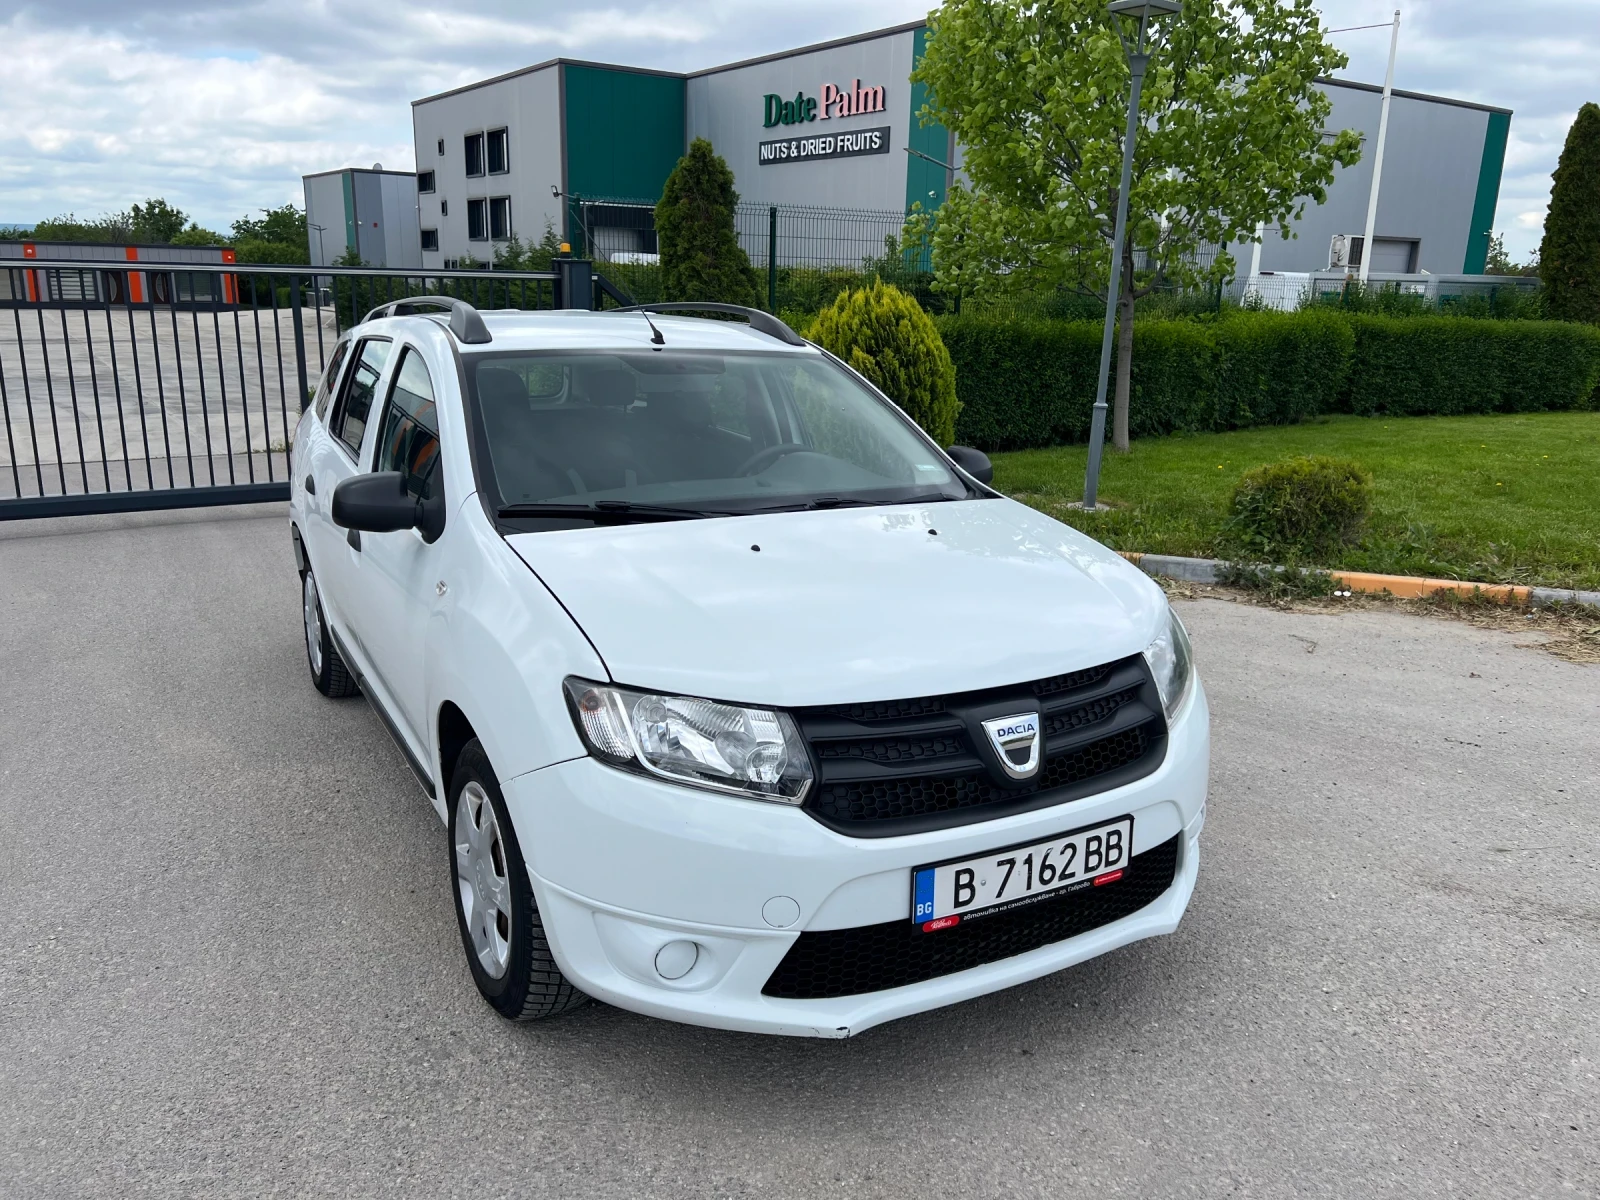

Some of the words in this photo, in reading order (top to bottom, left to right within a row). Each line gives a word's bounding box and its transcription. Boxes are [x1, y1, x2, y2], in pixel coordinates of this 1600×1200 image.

[763, 91, 817, 128] Date
[818, 78, 886, 120] Palm
[760, 142, 788, 160] NUTS
[790, 141, 798, 157] &
[800, 136, 835, 156] DRIED
[837, 131, 882, 152] FRUITS
[997, 723, 1035, 738] DACIA
[916, 901, 932, 916] BG
